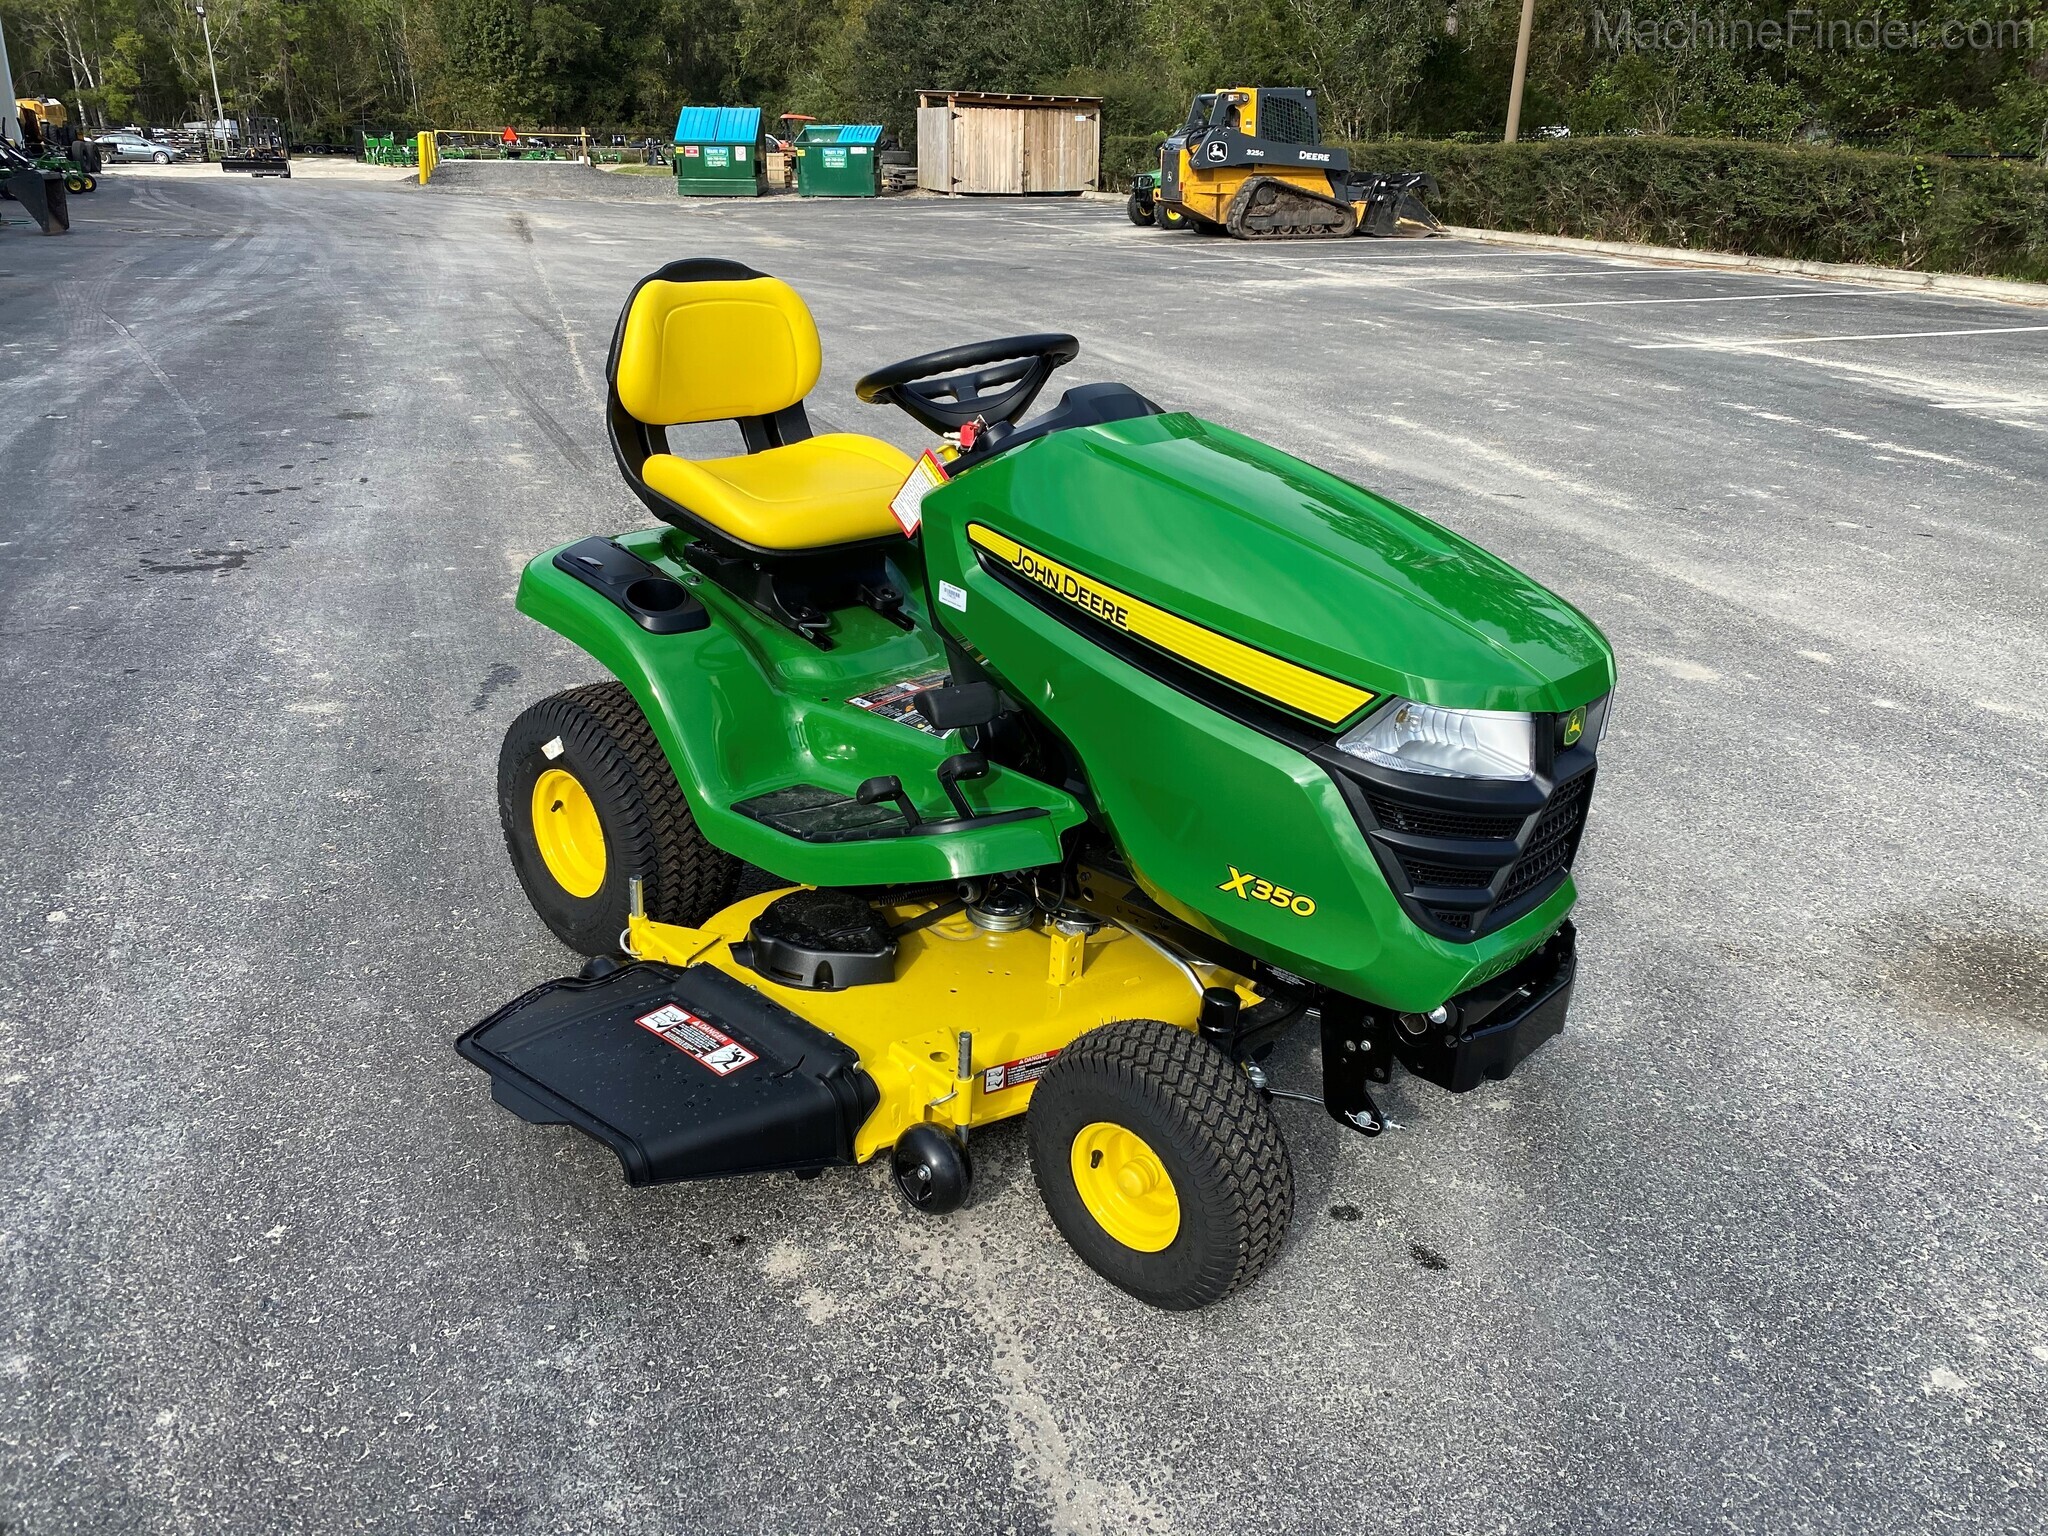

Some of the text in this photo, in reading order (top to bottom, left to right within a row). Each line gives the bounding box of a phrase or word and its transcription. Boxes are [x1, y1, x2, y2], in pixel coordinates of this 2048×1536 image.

[1299, 150, 1331, 162] DEERE
[1011, 547, 1129, 631] JOHN DEERE
[1216, 864, 1317, 917] X350
[699, 1023, 728, 1042] DANGER
[1024, 1053, 1047, 1063] DANGER
